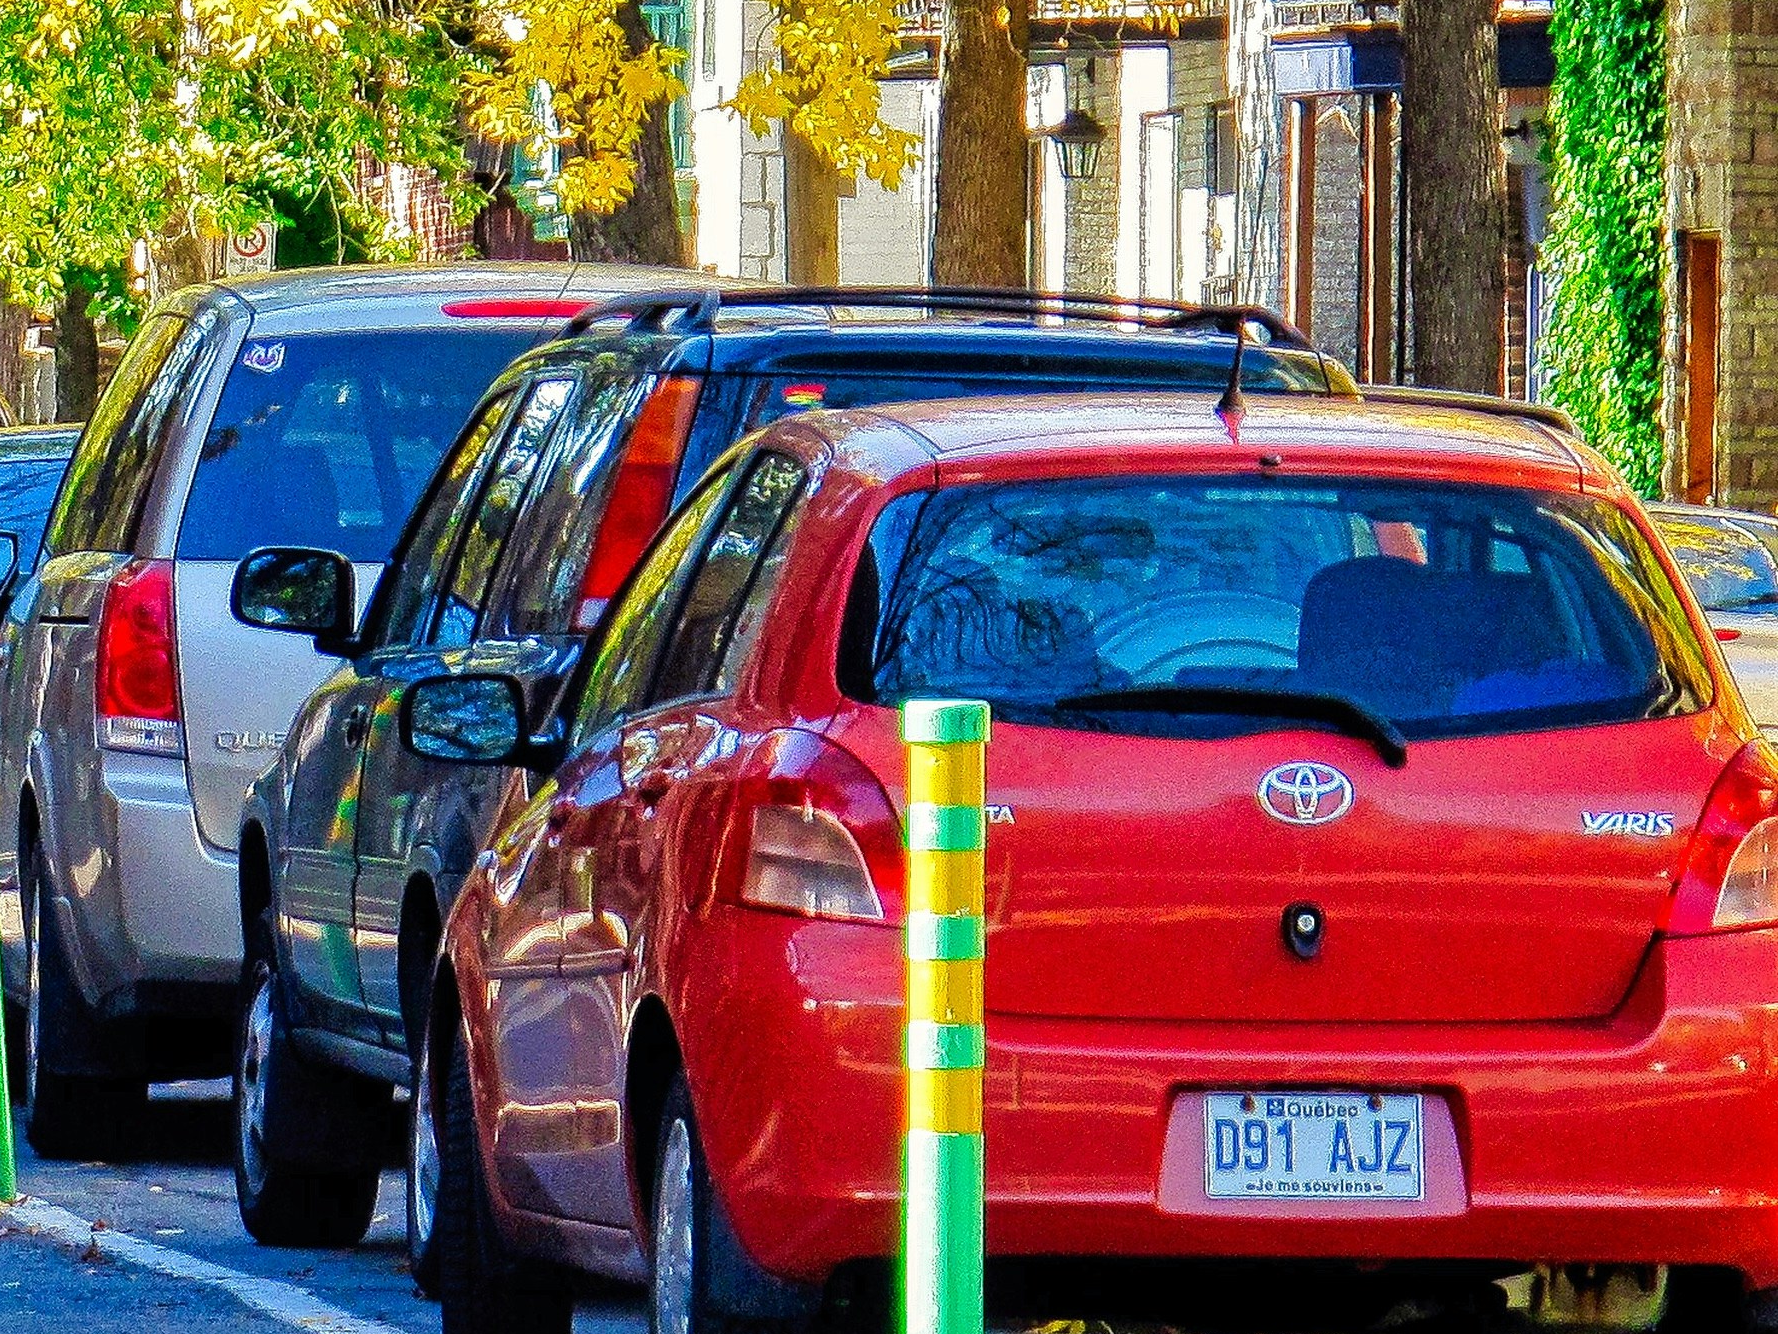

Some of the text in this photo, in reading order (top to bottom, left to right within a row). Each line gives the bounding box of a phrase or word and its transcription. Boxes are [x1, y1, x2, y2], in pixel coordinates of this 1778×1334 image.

[1288, 1100, 1358, 1117] Québec
[1215, 1119, 1411, 1172] D91 AJZ
